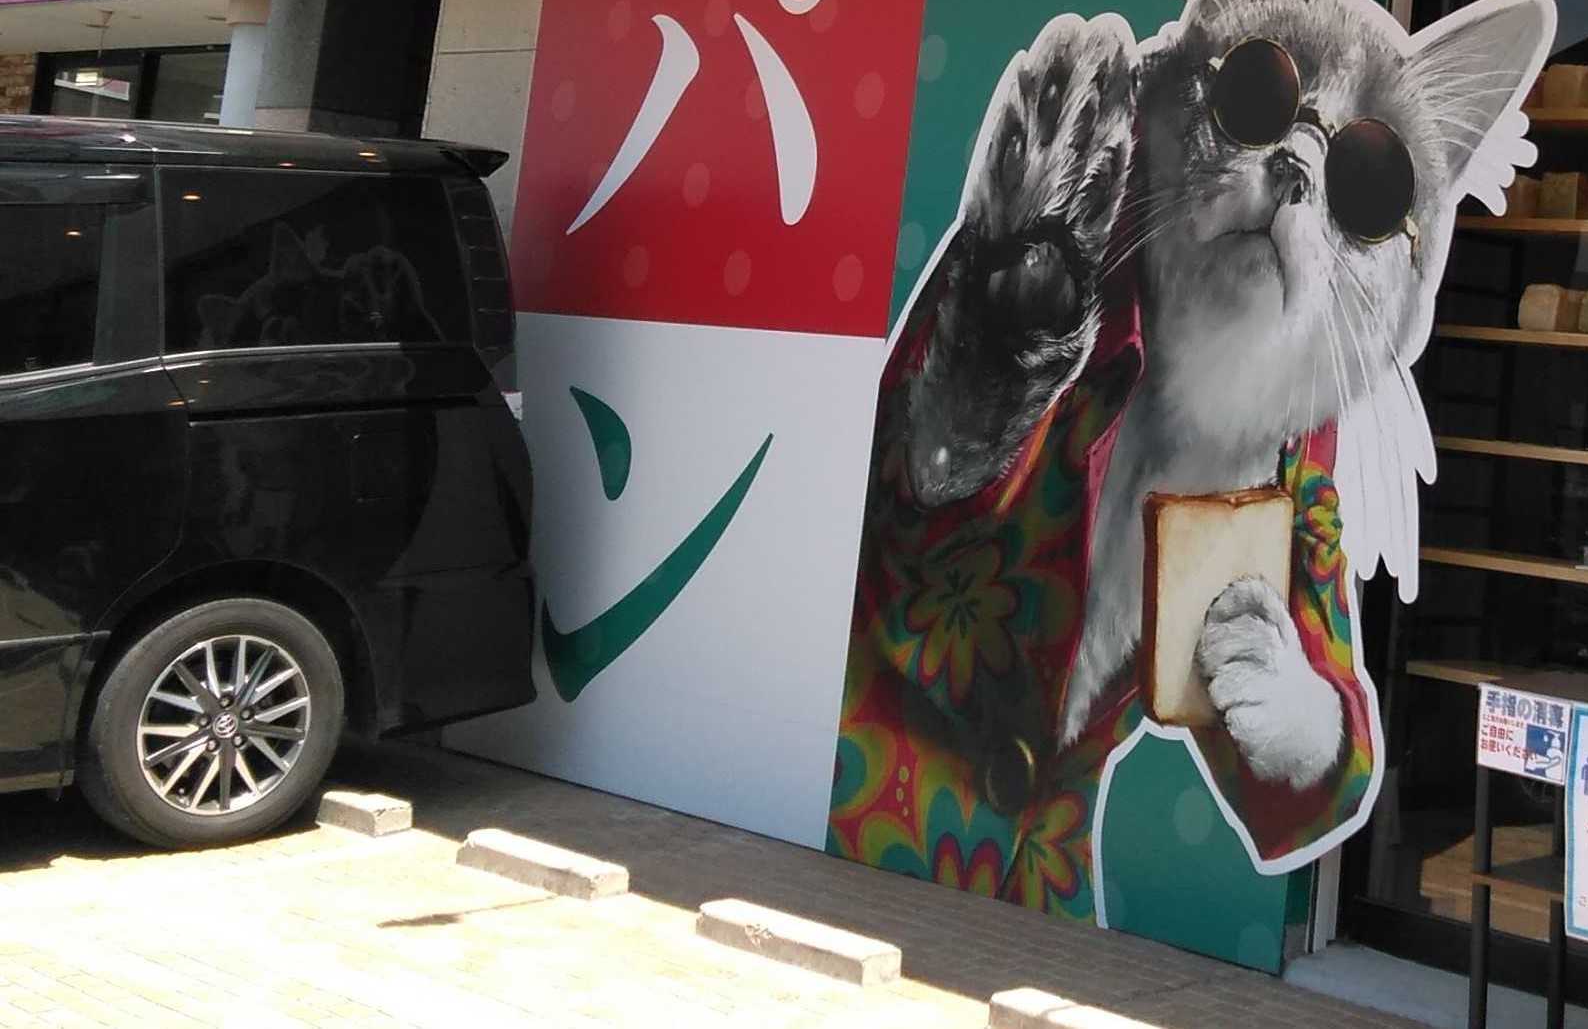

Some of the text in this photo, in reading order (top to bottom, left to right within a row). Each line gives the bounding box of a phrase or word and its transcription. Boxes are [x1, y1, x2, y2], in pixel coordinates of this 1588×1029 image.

[1486, 690, 1564, 728] 手指の消毒
[1481, 724, 1514, 741] ご自由に
